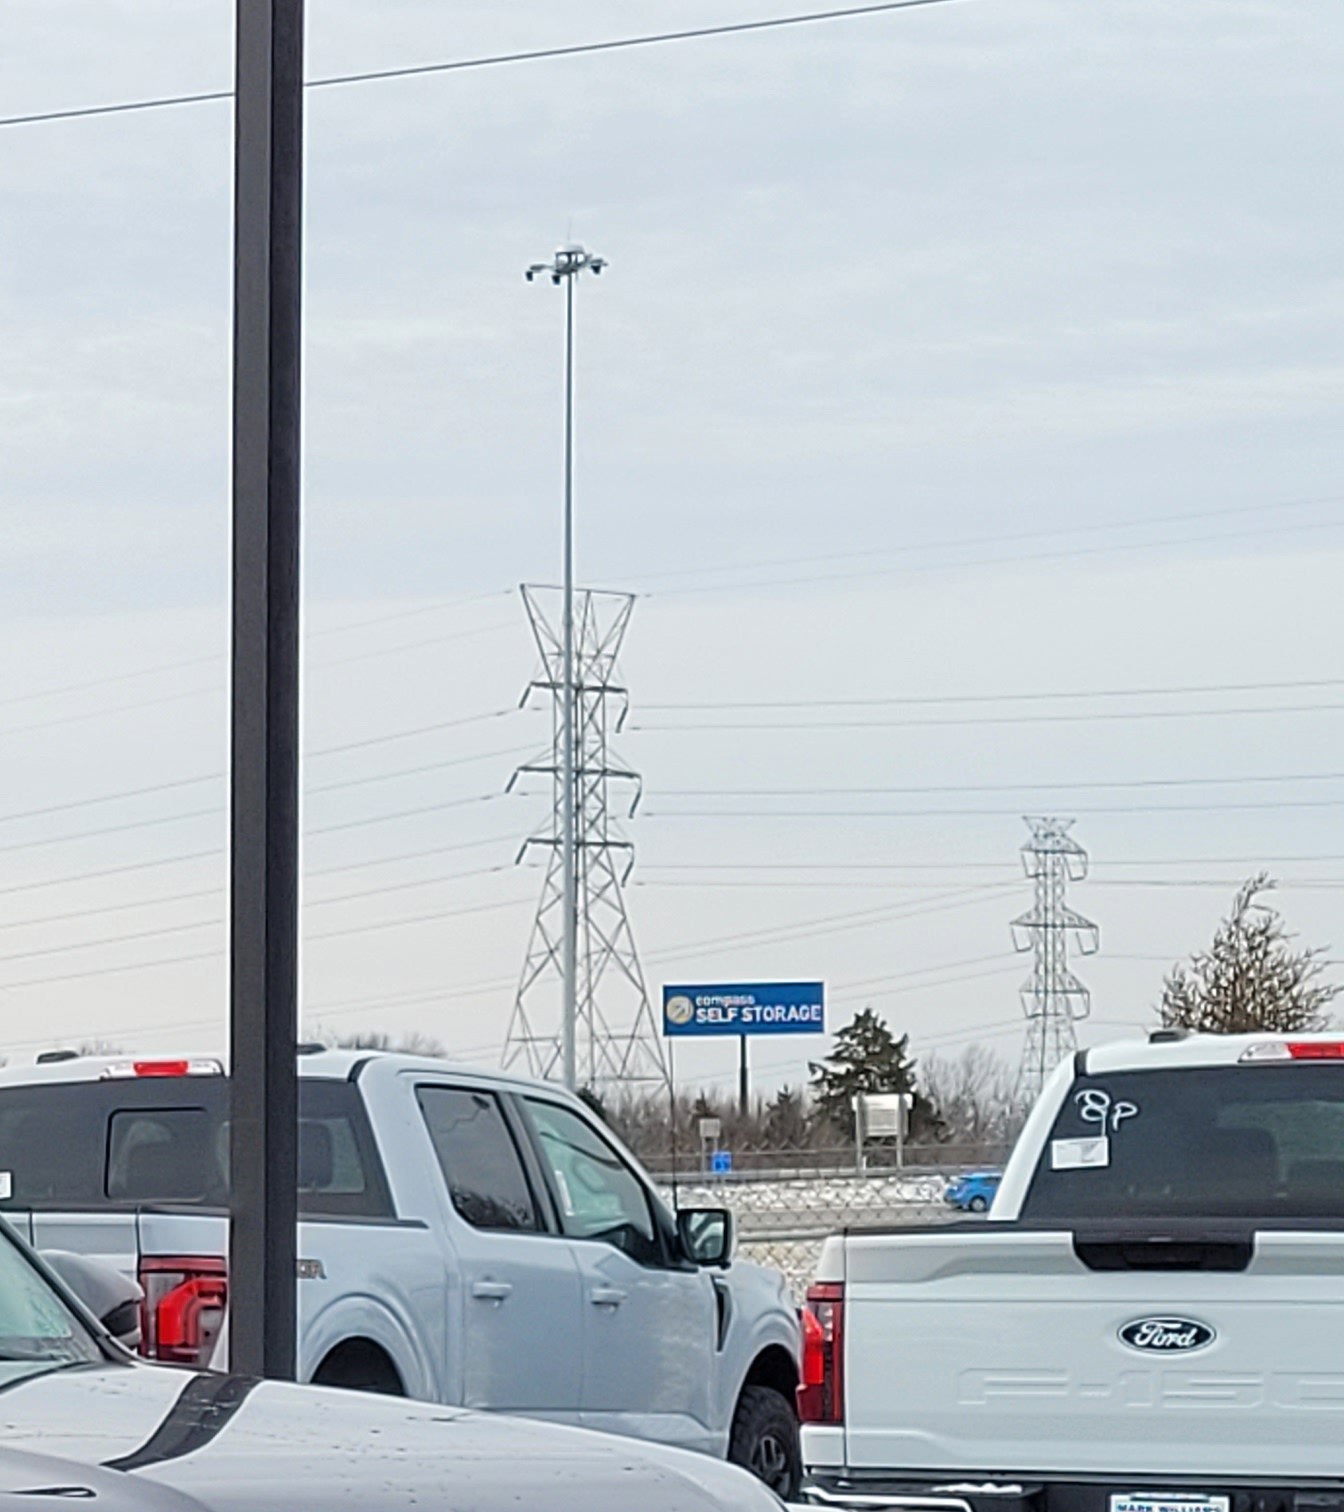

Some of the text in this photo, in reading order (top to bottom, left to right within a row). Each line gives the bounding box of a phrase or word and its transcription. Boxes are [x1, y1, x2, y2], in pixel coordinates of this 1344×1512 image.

[696, 1005, 822, 1023] SELF STORAGE
[1117, 1504, 1153, 1512] MARK
